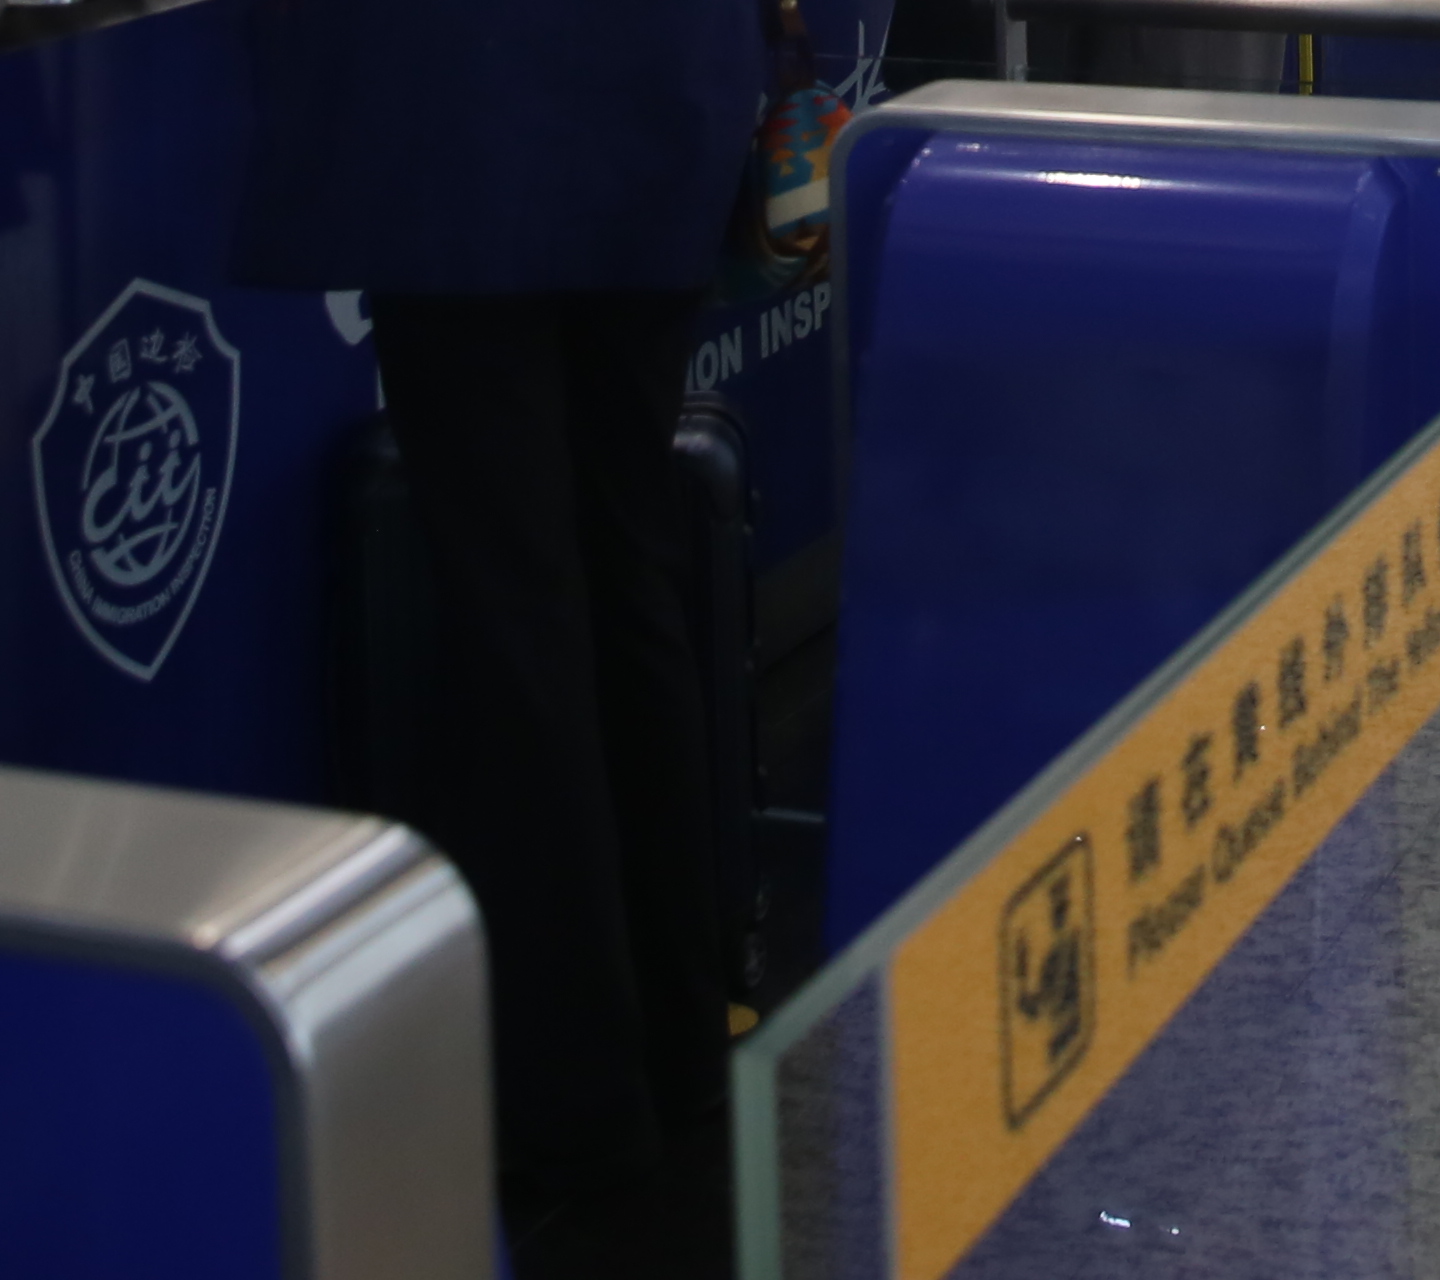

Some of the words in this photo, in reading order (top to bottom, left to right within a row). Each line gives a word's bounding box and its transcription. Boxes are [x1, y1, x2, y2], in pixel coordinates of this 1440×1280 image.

[72, 328, 202, 415] 中国边检
[67, 548, 93, 607] CHINA
[91, 589, 171, 627] IMMIGRATION
[168, 486, 218, 601] INSPECTION
